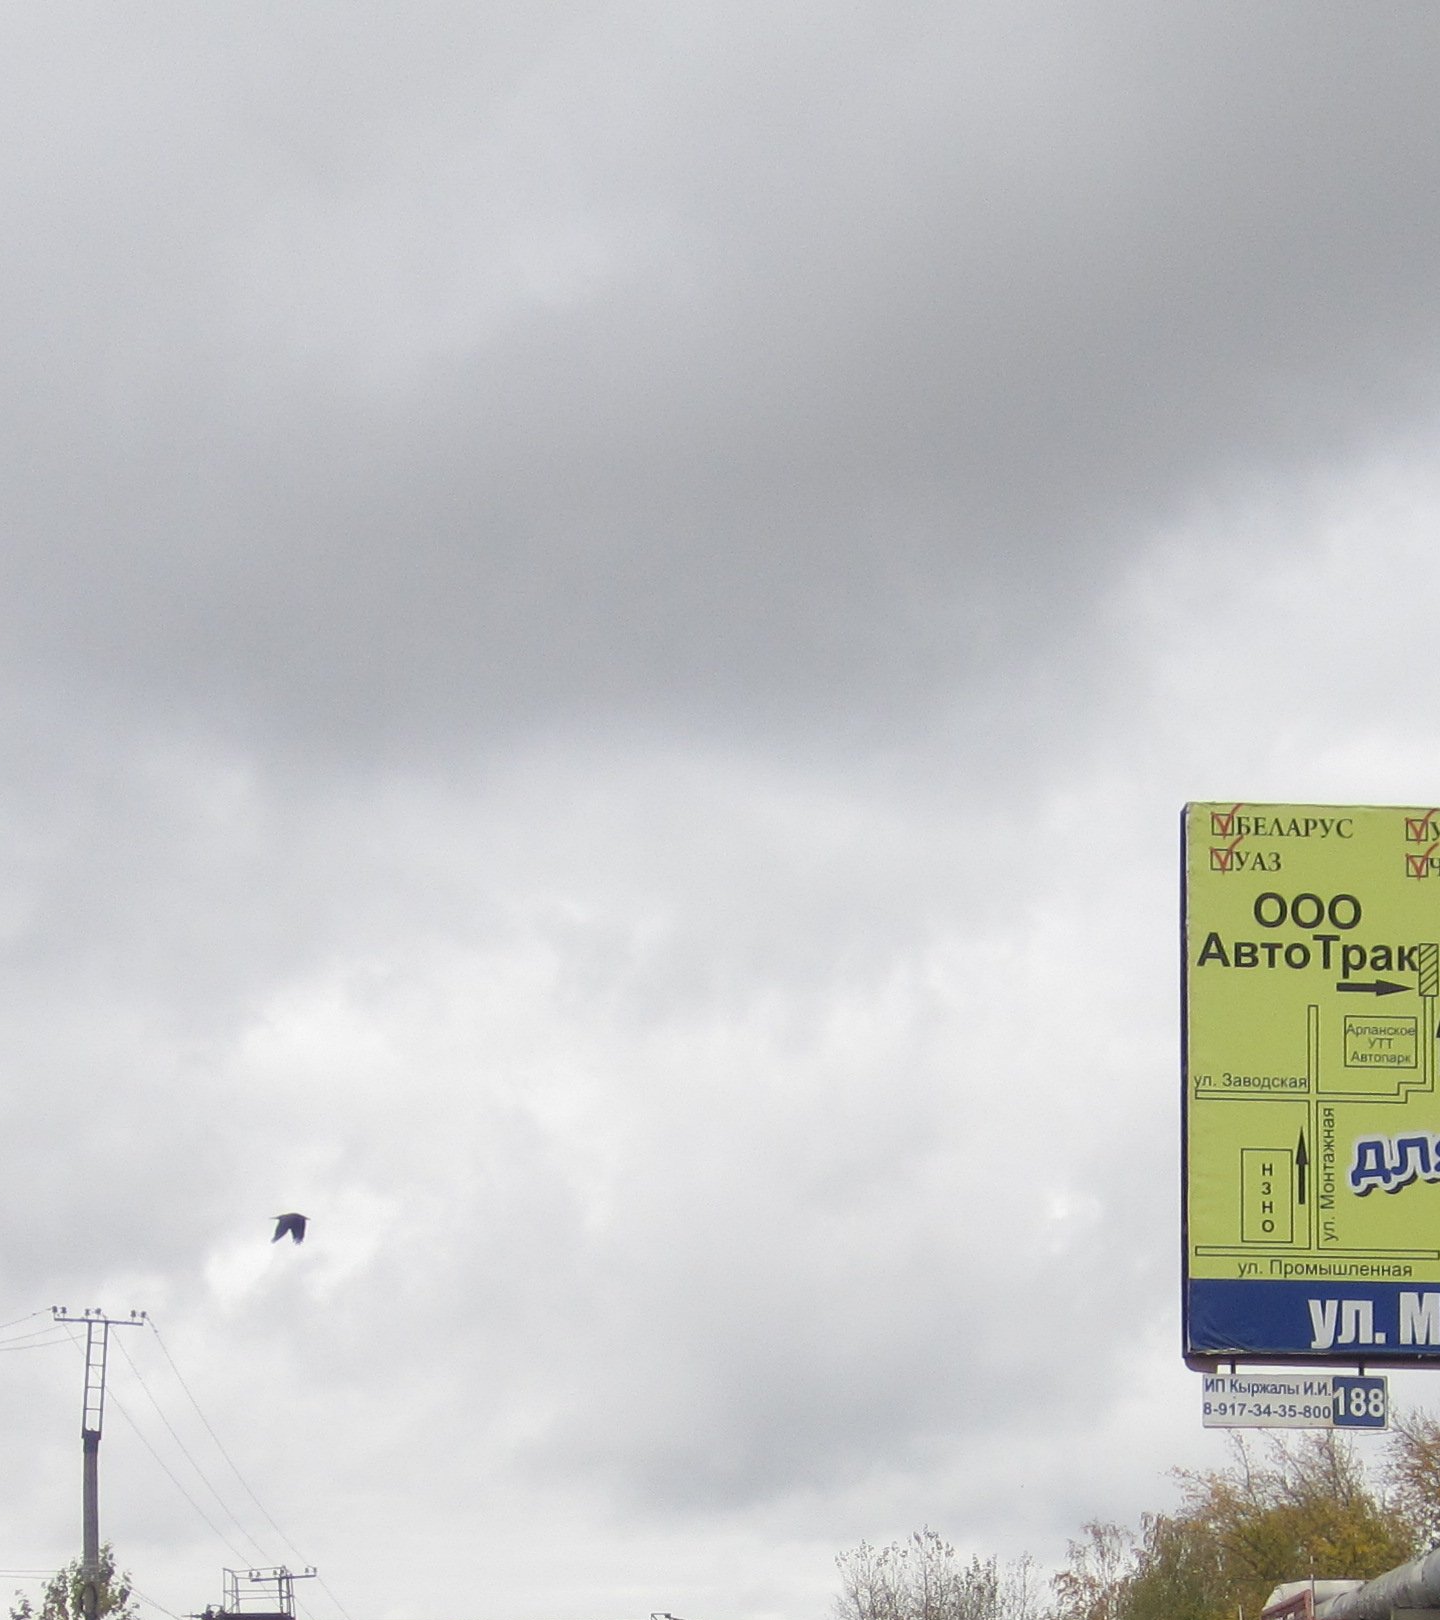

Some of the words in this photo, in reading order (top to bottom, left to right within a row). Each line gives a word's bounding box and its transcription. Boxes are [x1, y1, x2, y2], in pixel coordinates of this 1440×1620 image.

[1236, 815, 1354, 839] БЕЛАРУС
[1235, 851, 1282, 873] УАЗ
[1254, 892, 1363, 931] ООО
[1196, 932, 1420, 978] АвтоТрак
[1367, 1037, 1394, 1049] УТТ
[1350, 1050, 1412, 1065] Автопарк
[1194, 1075, 1217, 1089] ул.
[1222, 1073, 1308, 1089] Заводская
[1320, 1107, 1335, 1210] Монтажная
[1323, 1216, 1339, 1242] ул.
[1237, 1263, 1263, 1277] ул.
[1269, 1259, 1413, 1278] Промышленная
[1308, 1298, 1386, 1349] ул.
[1204, 1378, 1226, 1393] ИП
[1303, 1381, 1332, 1396] И.И.
[1203, 1402, 1332, 1419] 8-917-34-35-800
[1333, 1386, 1385, 1418] 188
